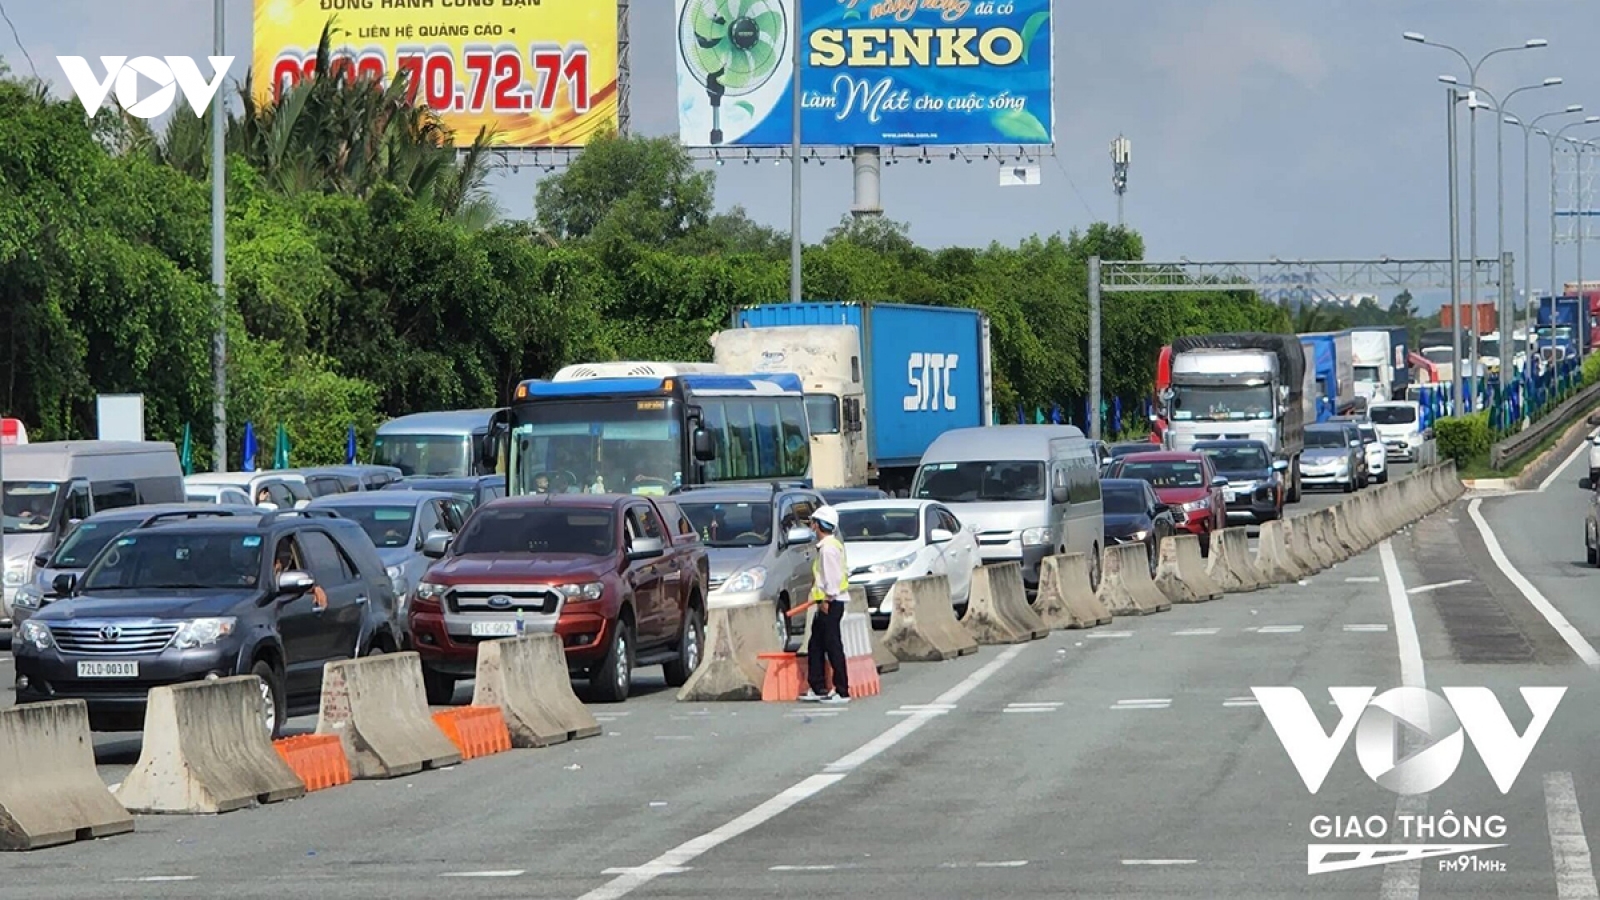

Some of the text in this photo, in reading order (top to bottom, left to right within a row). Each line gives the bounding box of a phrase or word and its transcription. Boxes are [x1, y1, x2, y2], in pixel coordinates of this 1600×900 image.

[974, 1, 993, 15] đã
[997, 1, 1014, 15] có
[358, 24, 390, 37] LIÊN
[395, 24, 413, 39] HỆ
[474, 22, 503, 37] CÁO
[809, 27, 1024, 67] SENKO
[800, 73, 1026, 123] Làm Mát cho cuộc sống
[903, 352, 960, 411] SITC
